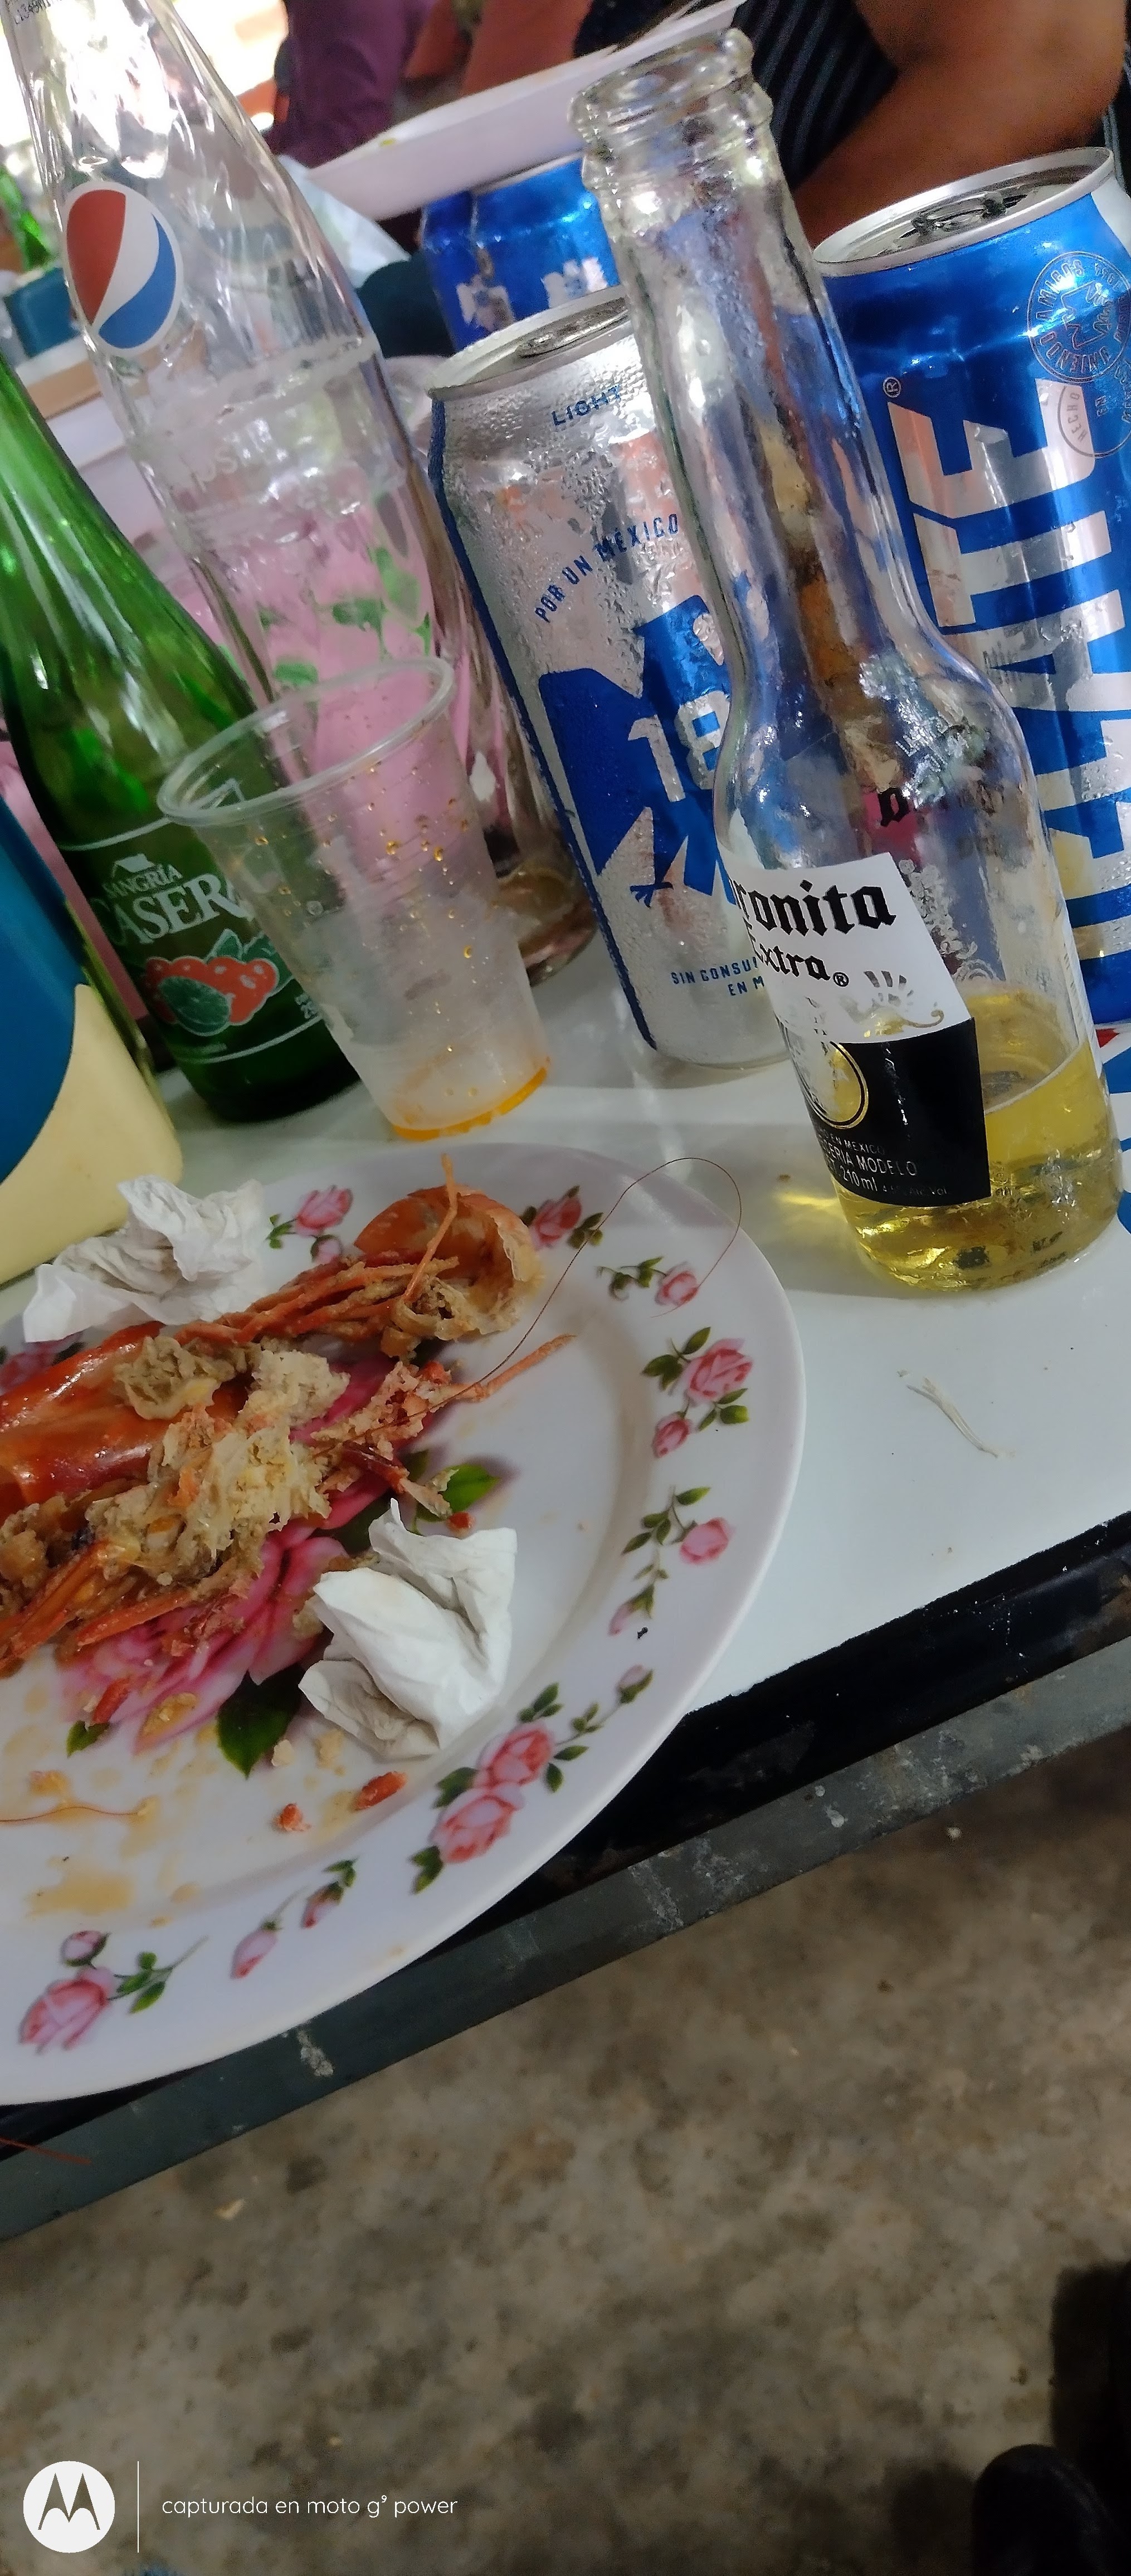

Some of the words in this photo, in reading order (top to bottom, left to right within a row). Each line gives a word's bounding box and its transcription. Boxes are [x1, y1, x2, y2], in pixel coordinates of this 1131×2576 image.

[1067, 392, 1088, 442] HECHO
[535, 584, 566, 623] POR
[562, 555, 593, 585] UN
[89, 873, 254, 946] CASER
[728, 878, 897, 936] ronita
[671, 971, 696, 985] SIN
[728, 981, 748, 996] EN
[856, 1154, 918, 1177] MODELO
